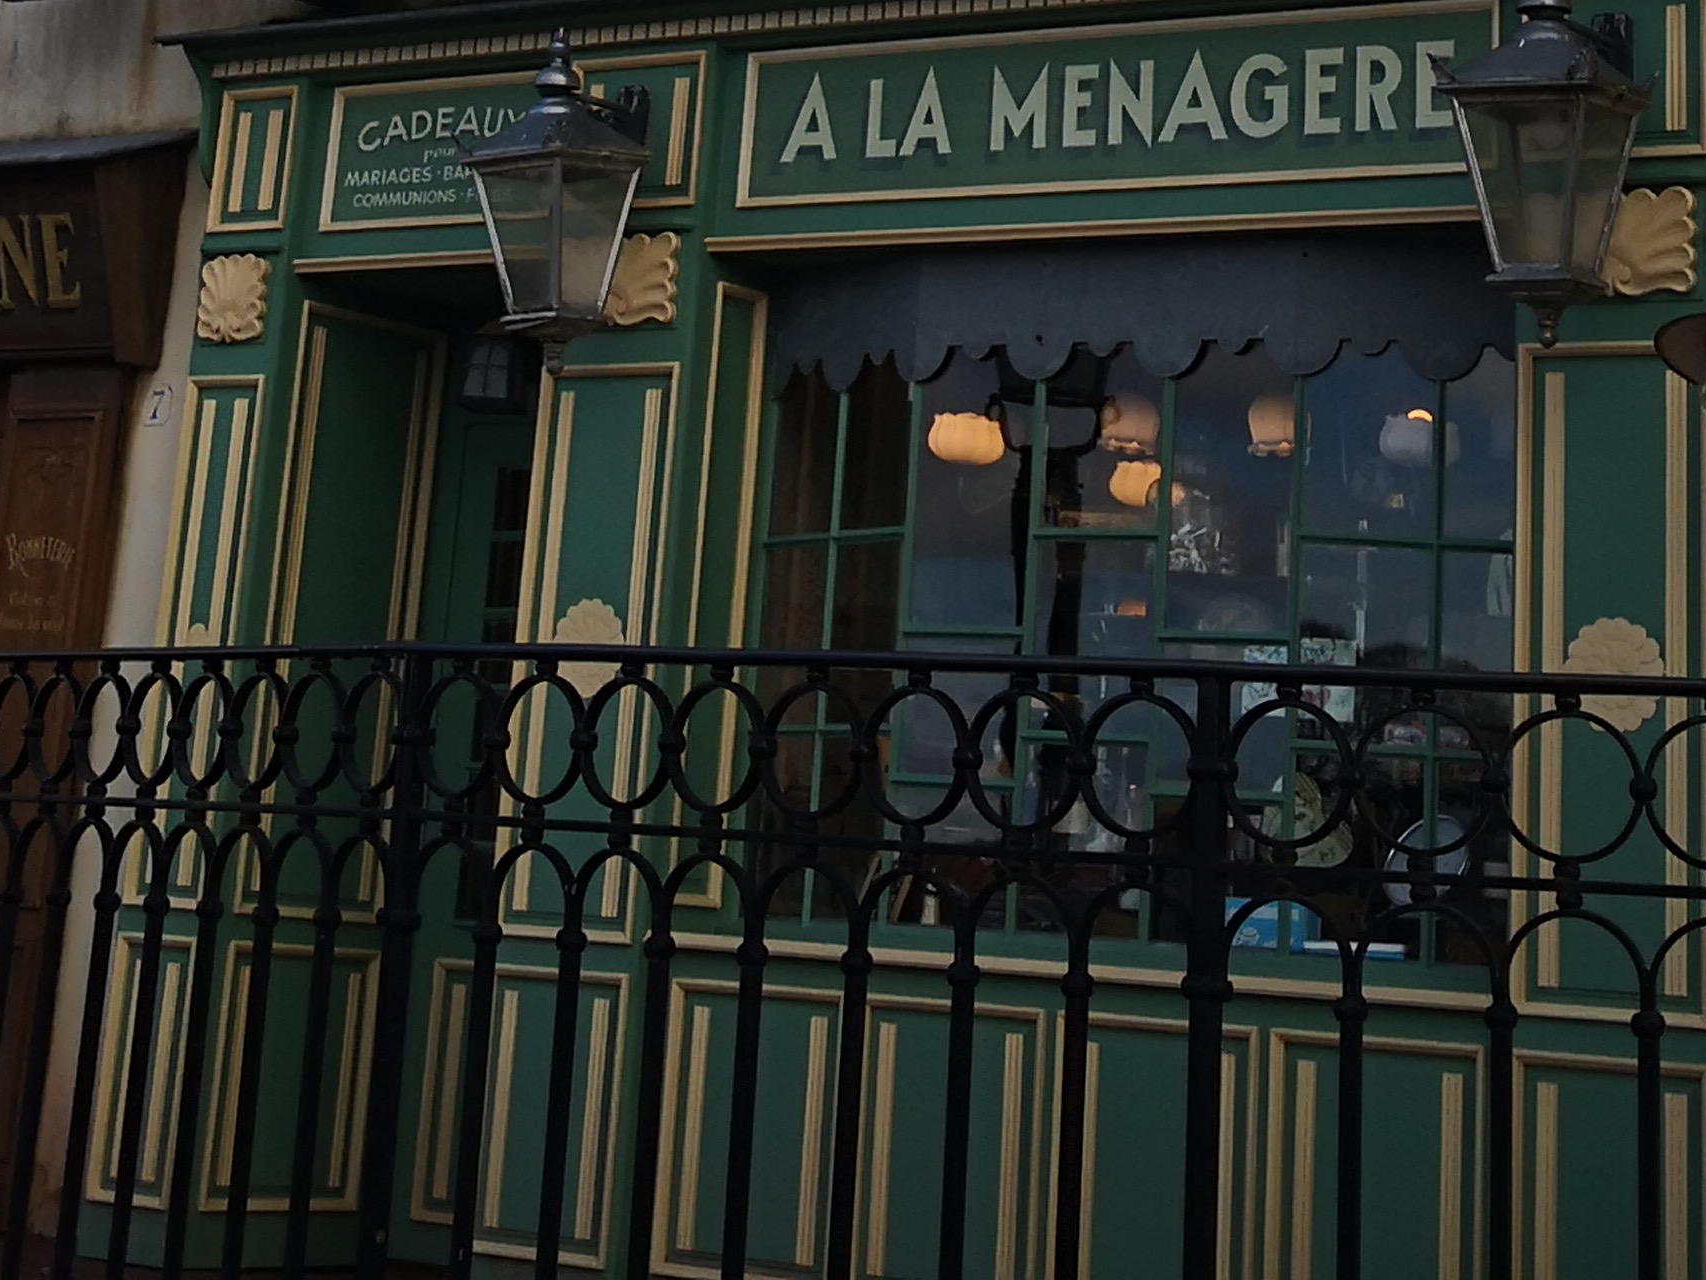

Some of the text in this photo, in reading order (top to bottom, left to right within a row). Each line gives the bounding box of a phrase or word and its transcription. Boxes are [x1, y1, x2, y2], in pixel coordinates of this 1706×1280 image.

[778, 39, 1457, 165] A LA MENAGERE
[344, 165, 433, 188] MARIAGES
[352, 188, 457, 208] COMMUNIONS
[148, 392, 166, 422] 7
